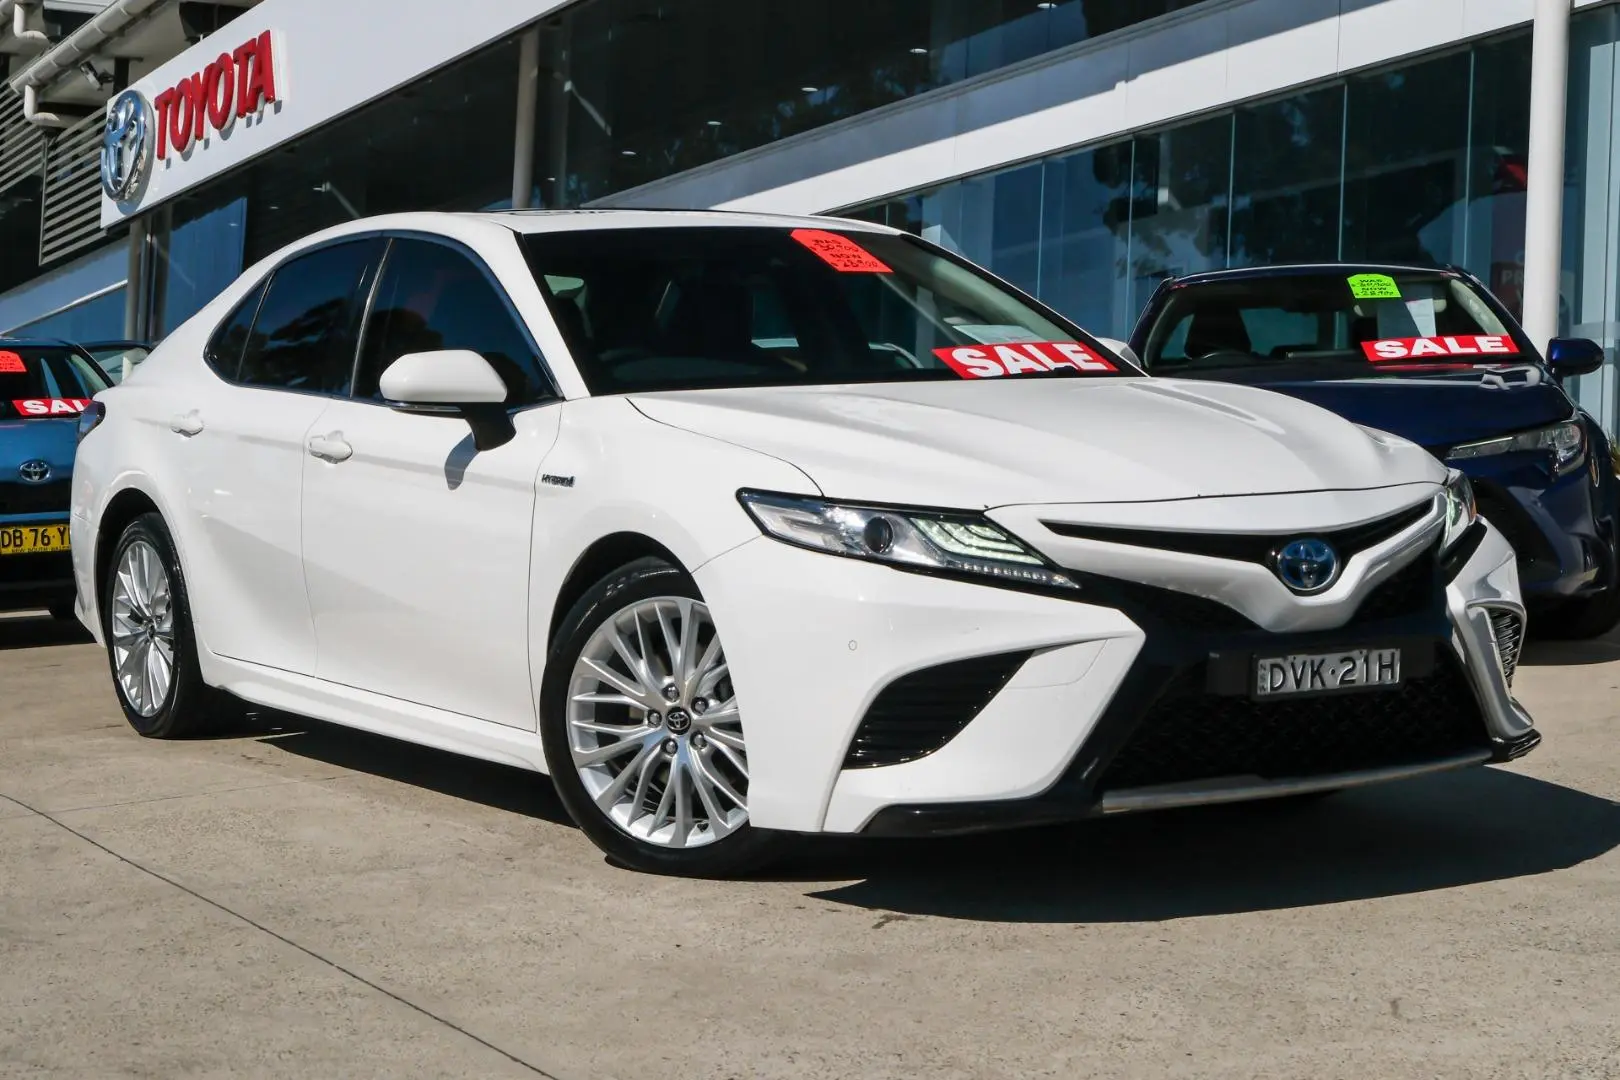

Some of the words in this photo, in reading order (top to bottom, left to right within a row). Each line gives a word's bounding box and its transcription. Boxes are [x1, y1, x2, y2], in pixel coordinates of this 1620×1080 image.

[154, 29, 276, 160] TOYOTA
[951, 343, 1108, 378] SALE
[1374, 336, 1510, 359] SALE
